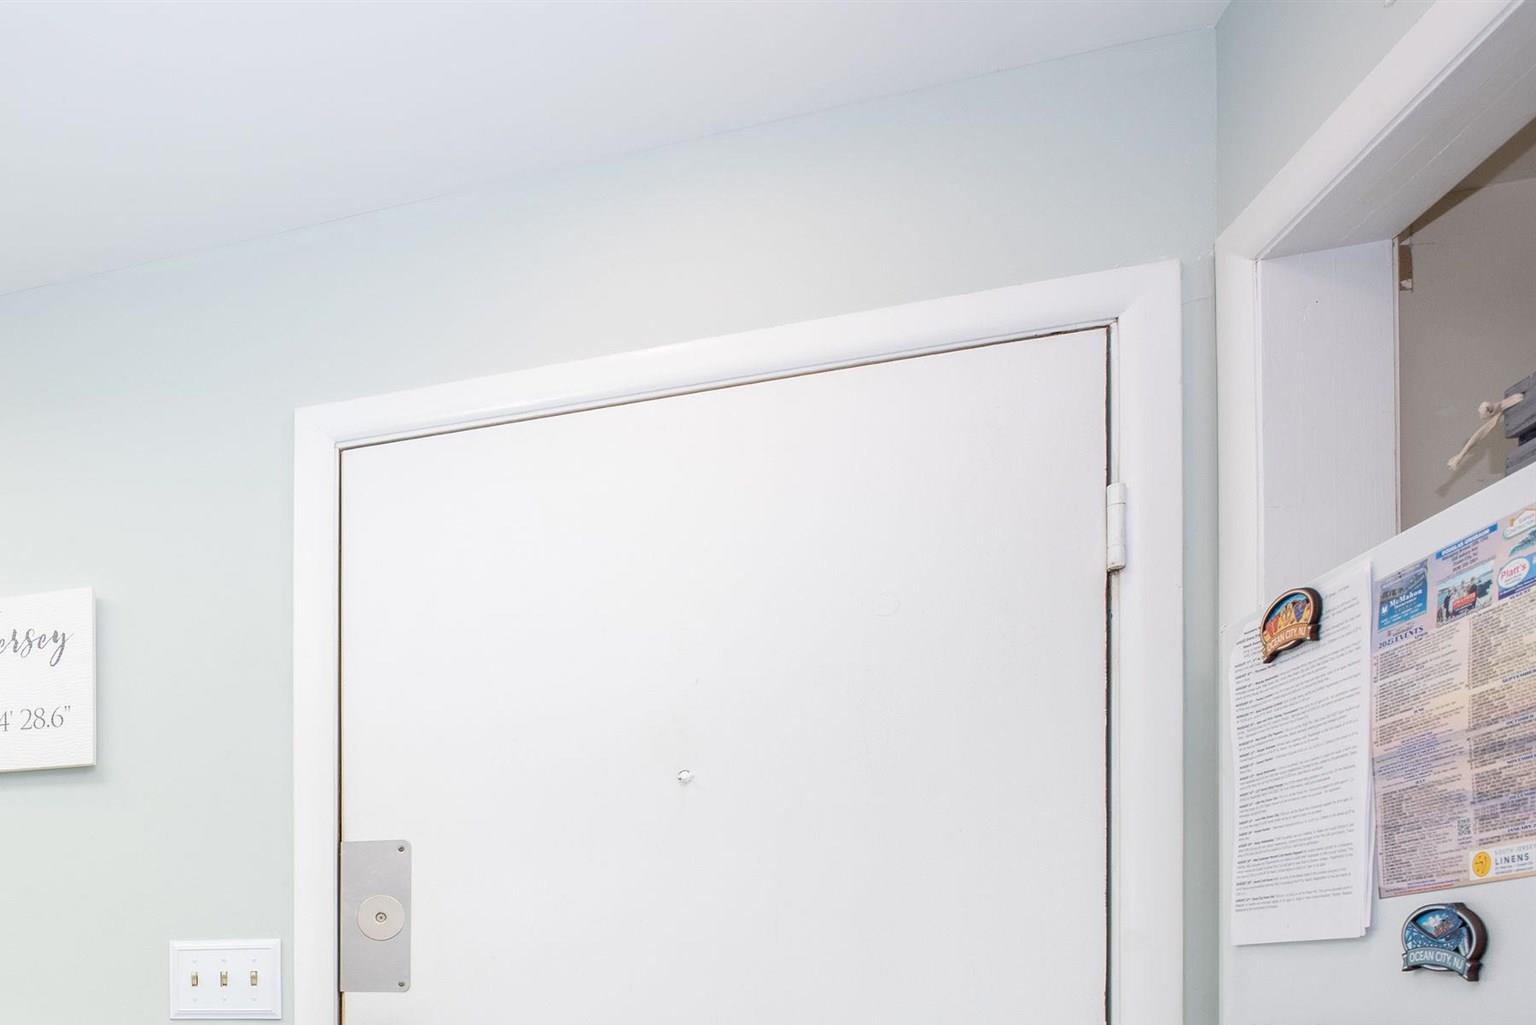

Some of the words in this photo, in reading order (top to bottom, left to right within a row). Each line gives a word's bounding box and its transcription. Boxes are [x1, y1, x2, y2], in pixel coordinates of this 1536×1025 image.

[1495, 852, 1530, 865] LINENS
[1409, 950, 1434, 963] OCEAN
[1453, 956, 1465, 970] NJ
